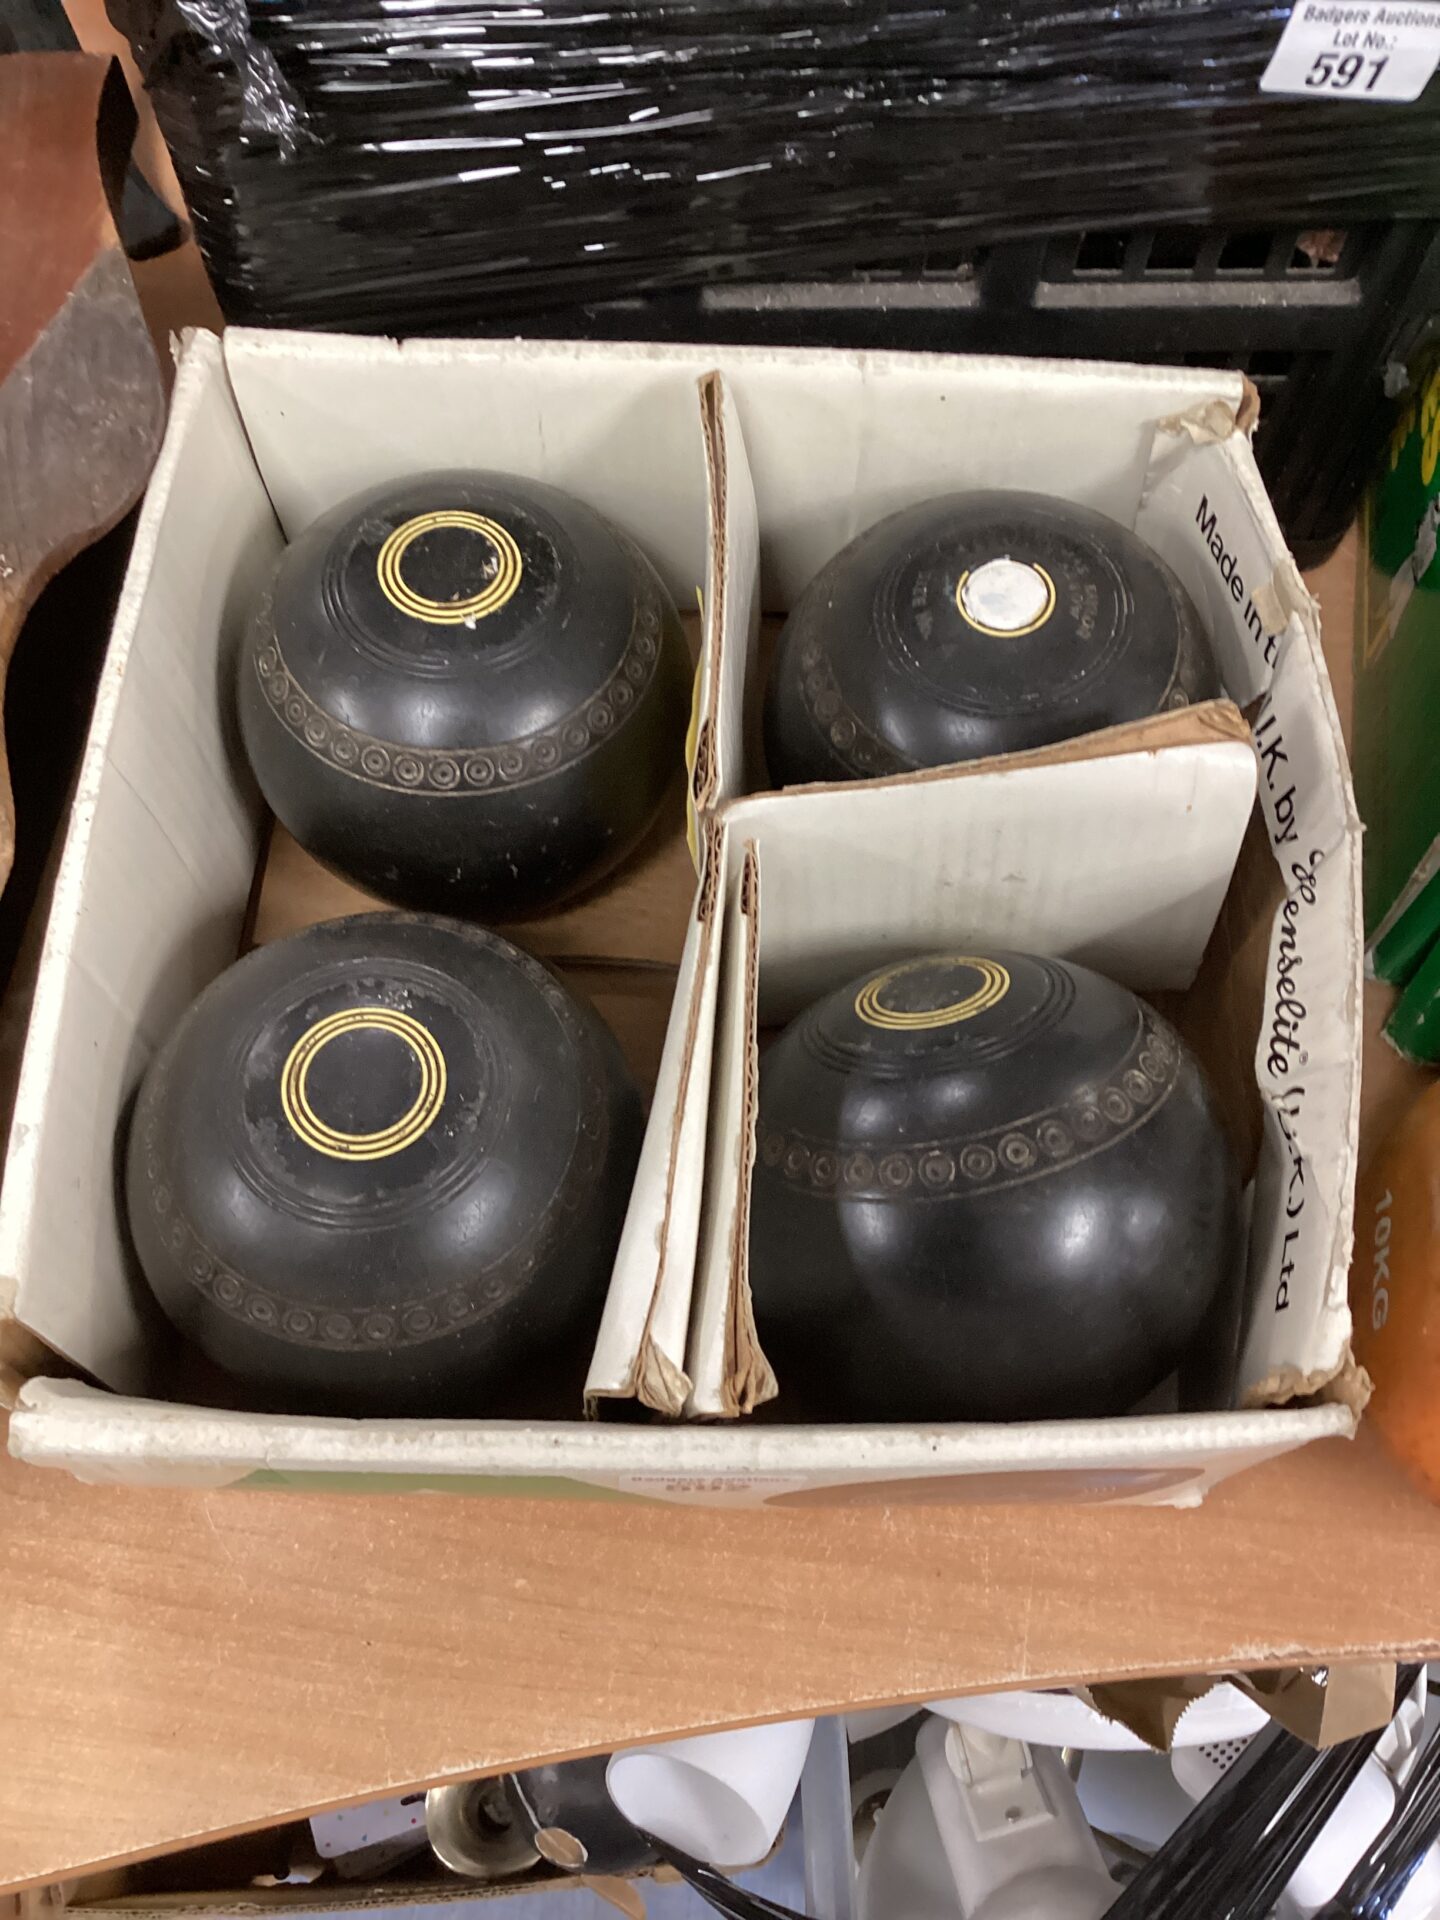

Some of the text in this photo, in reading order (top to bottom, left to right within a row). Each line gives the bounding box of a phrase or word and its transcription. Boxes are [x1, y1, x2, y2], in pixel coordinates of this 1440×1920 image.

[1303, 5, 1371, 26] Badgers
[1333, 29, 1359, 48] Lot
[1304, 53, 1389, 91] 591
[1195, 493, 1244, 603] Made
[1273, 784, 1299, 845] by
[1275, 1228, 1300, 1314] Ltd
[1372, 1188, 1393, 1331] 10KG
